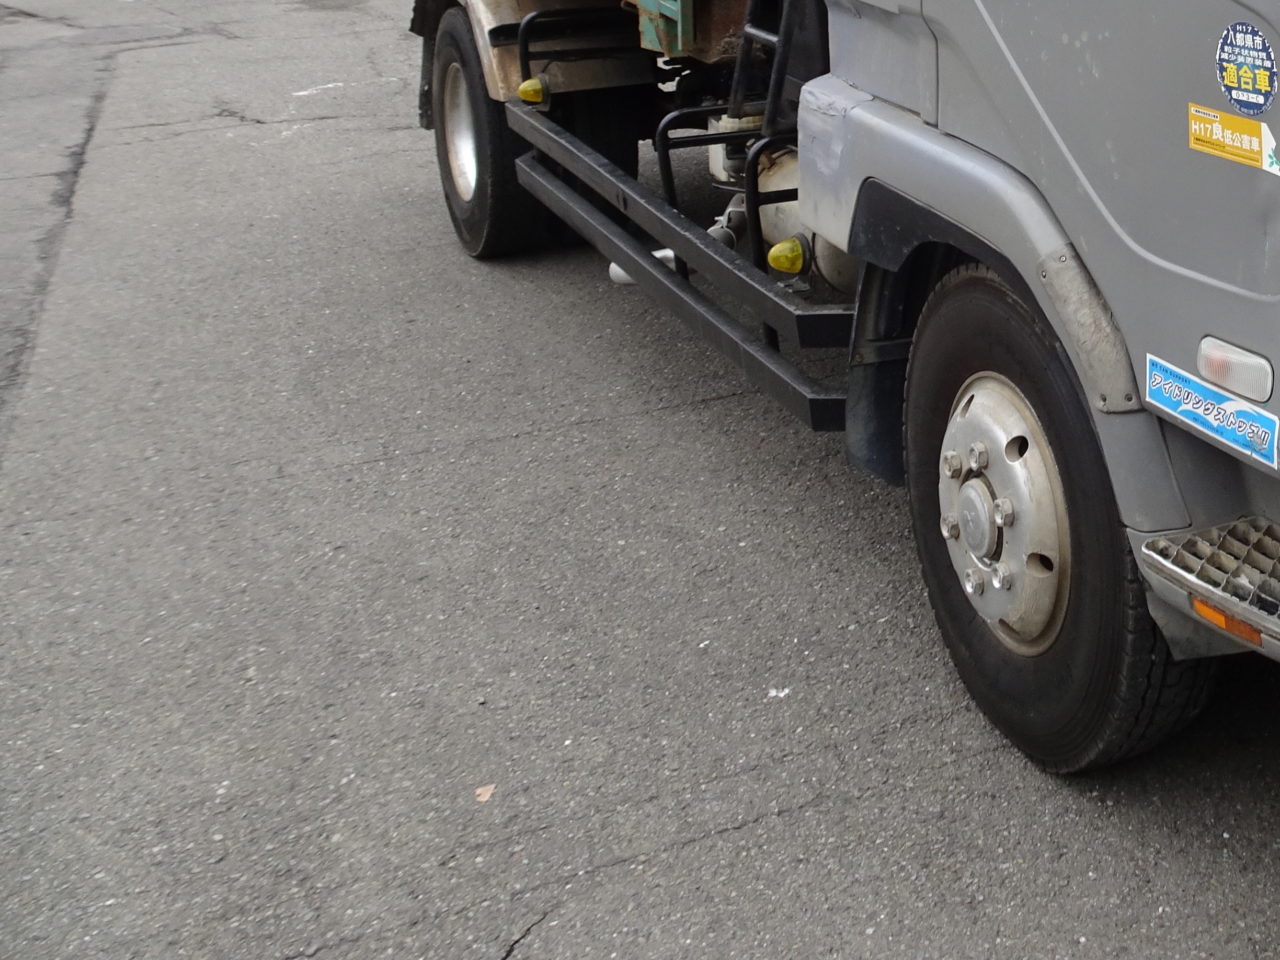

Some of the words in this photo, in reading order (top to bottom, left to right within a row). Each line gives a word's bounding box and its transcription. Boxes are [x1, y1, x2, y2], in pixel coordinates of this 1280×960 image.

[1236, 24, 1252, 33] H17
[1227, 30, 1263, 50] 八都県市
[1222, 62, 1271, 93] 適合車
